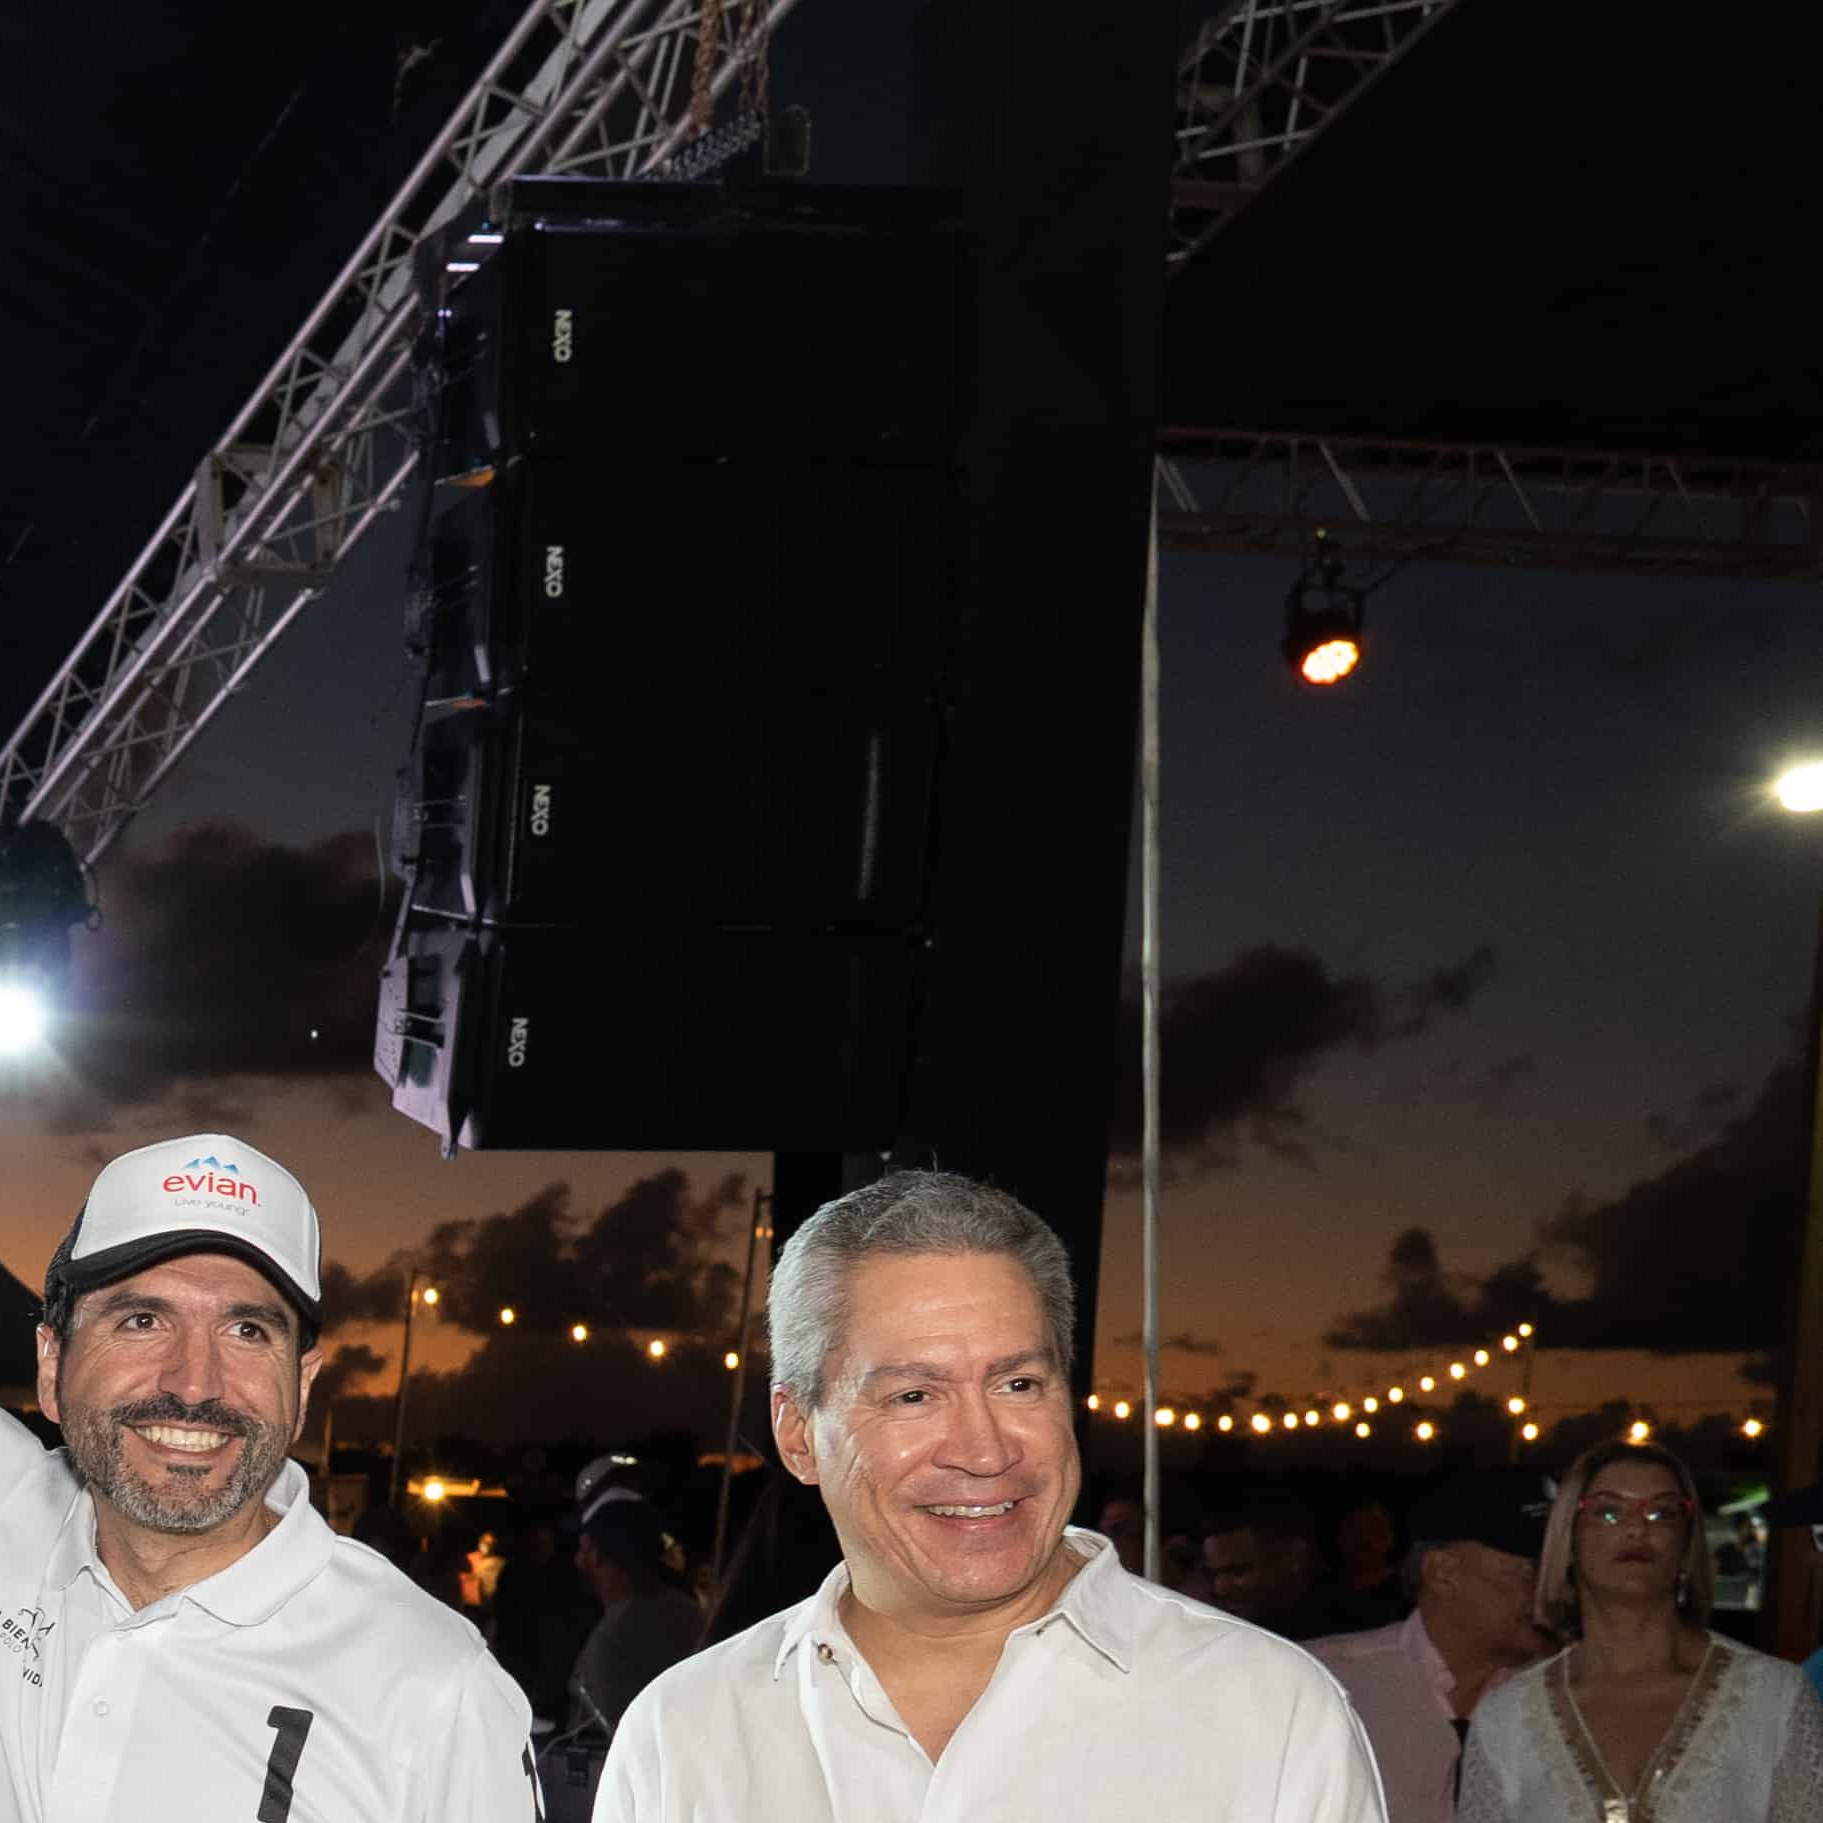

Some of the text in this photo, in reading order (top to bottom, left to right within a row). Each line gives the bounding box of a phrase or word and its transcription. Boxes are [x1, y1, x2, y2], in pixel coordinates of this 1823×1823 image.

[552, 308, 573, 364] NEXO
[544, 544, 564, 599] NEXO
[530, 783, 552, 838] NEXO
[507, 1016, 528, 1069] NEXO
